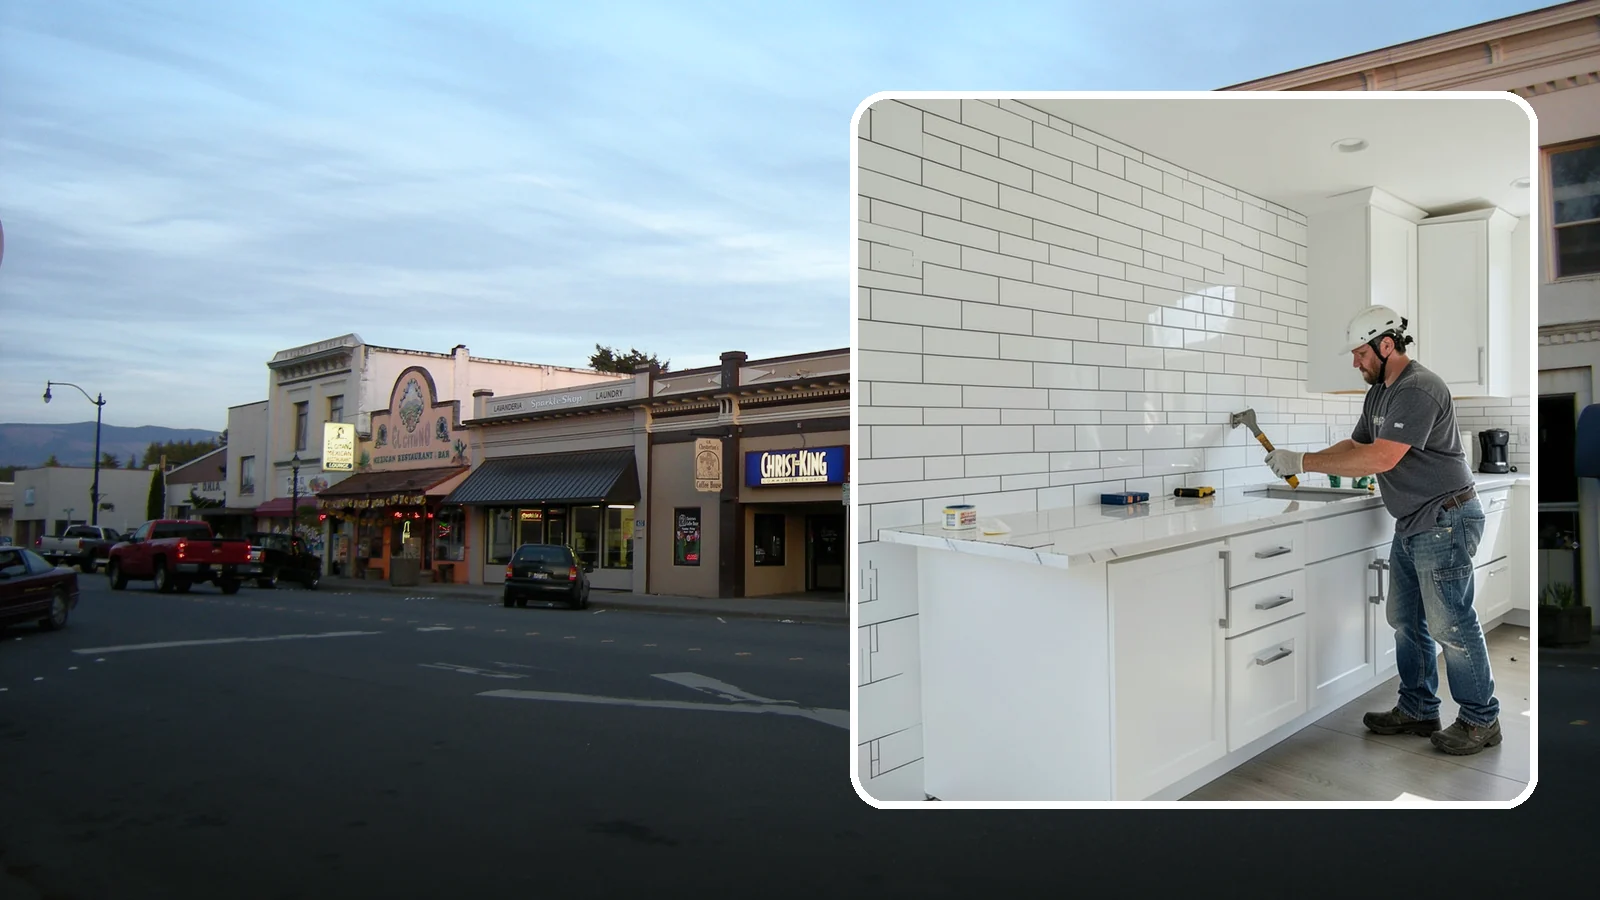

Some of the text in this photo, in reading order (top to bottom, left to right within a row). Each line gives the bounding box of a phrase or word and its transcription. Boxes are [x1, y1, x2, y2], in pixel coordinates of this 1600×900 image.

[561, 394, 583, 404] Shop
[595, 388, 623, 400] LAUNDRY
[493, 401, 522, 413] LAVANDERIA
[373, 450, 450, 464] MEXICAN RESTAURANT BAR
[799, 450, 827, 476] KING
[696, 480, 722, 488] Coffee House
